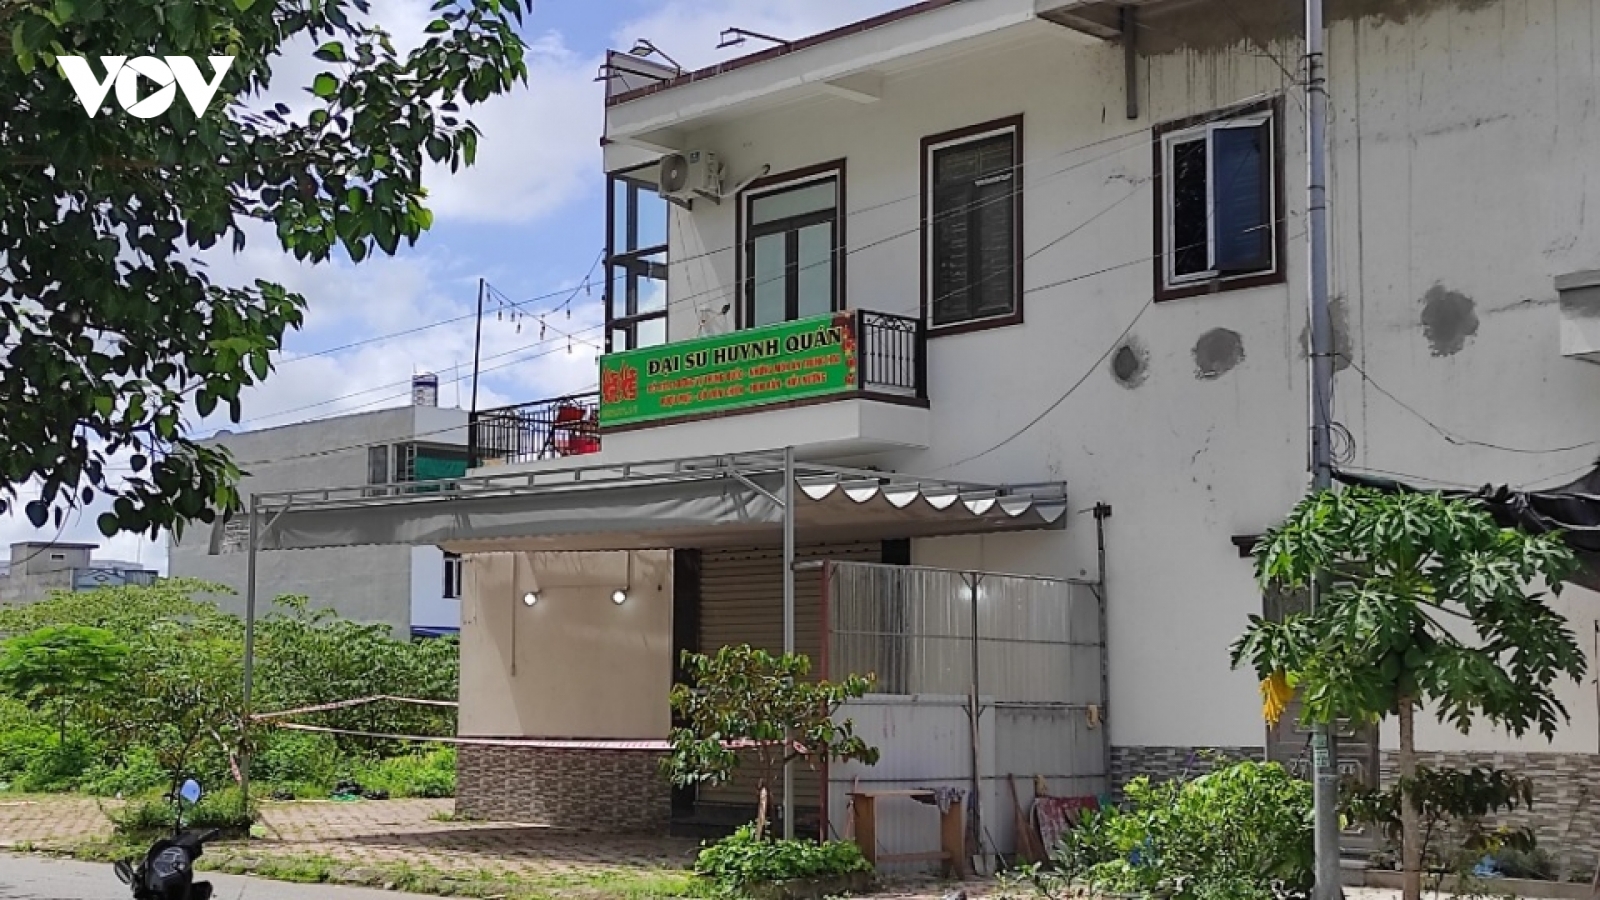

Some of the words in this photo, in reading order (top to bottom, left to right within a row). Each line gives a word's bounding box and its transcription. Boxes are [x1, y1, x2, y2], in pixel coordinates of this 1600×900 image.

[647, 355, 680, 377] ĐẠI
[712, 337, 780, 365] HUYNH
[785, 324, 842, 353] QUÁN
